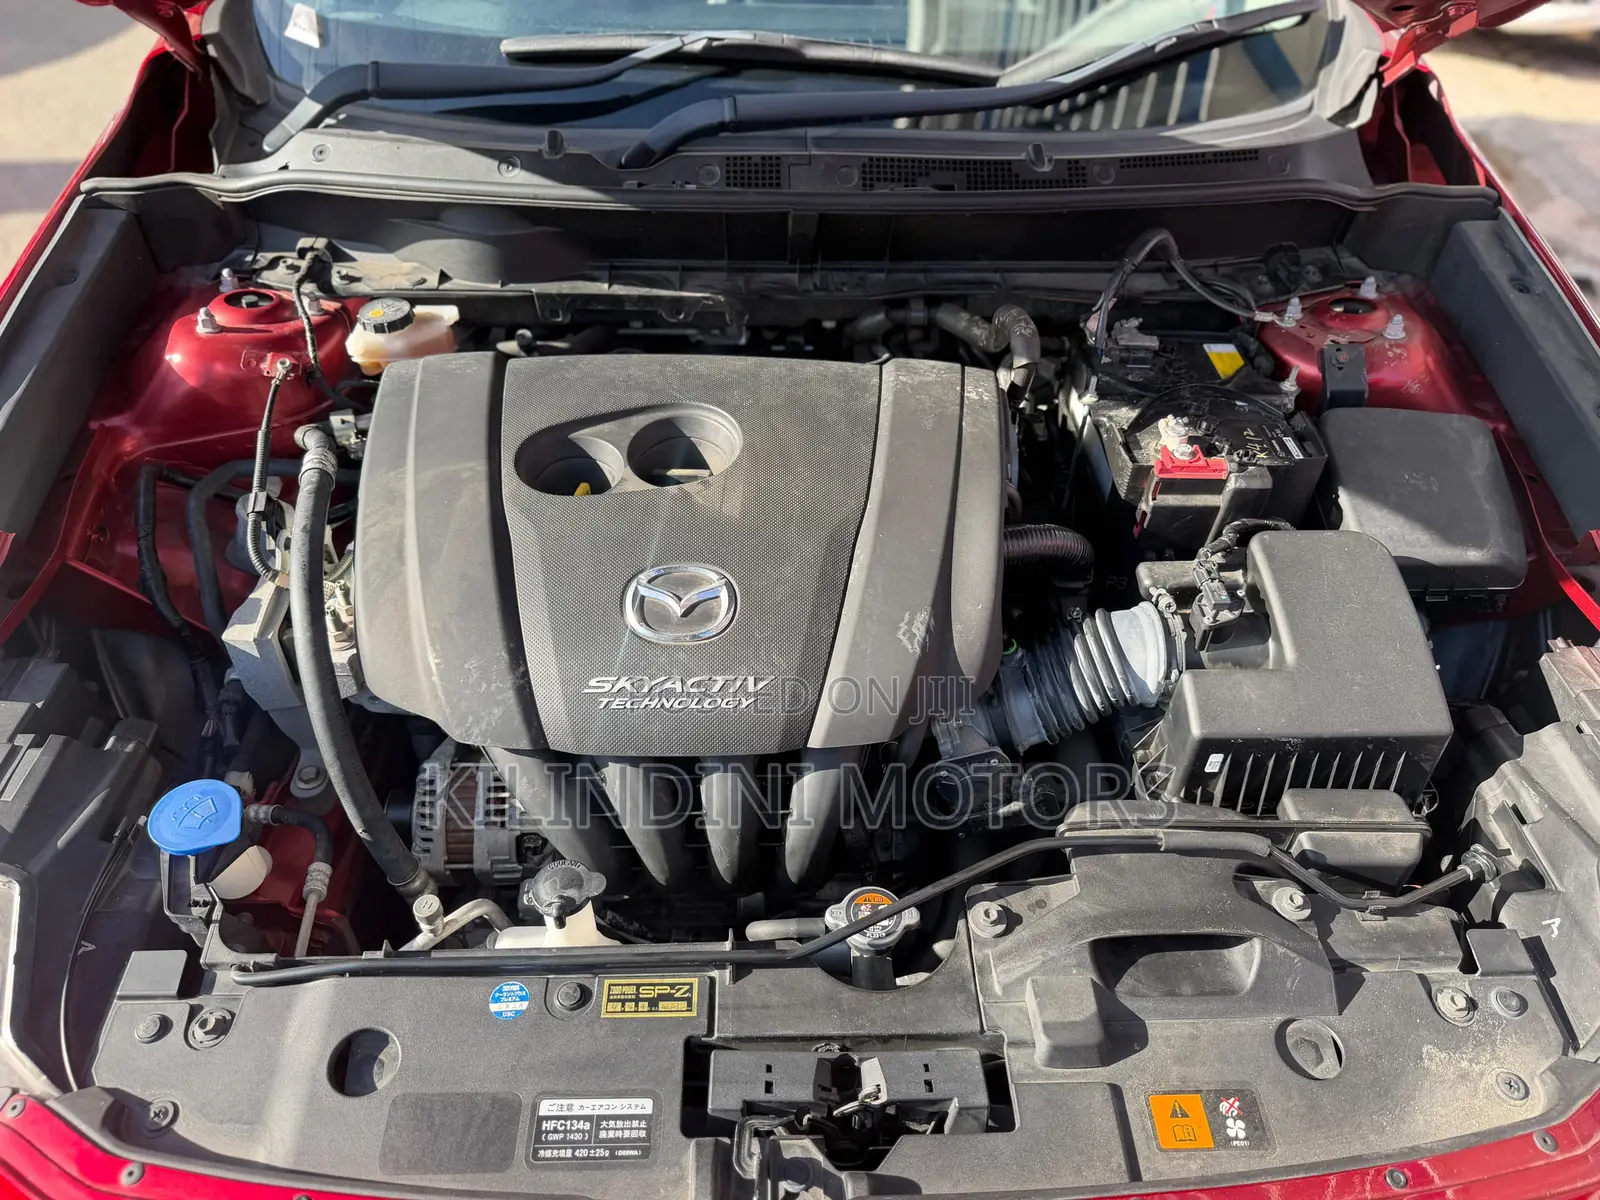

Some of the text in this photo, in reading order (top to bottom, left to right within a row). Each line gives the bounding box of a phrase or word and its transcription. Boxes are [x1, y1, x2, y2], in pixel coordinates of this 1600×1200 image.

[581, 676, 777, 694] SKYACTIV
[598, 697, 758, 710] TECHNOLOGY
[638, 985, 691, 998] SP-Z
[547, 1103, 575, 1112] ご注意
[542, 1120, 591, 1131] HFC134a
[600, 1119, 647, 1128] 大気放出禁止
